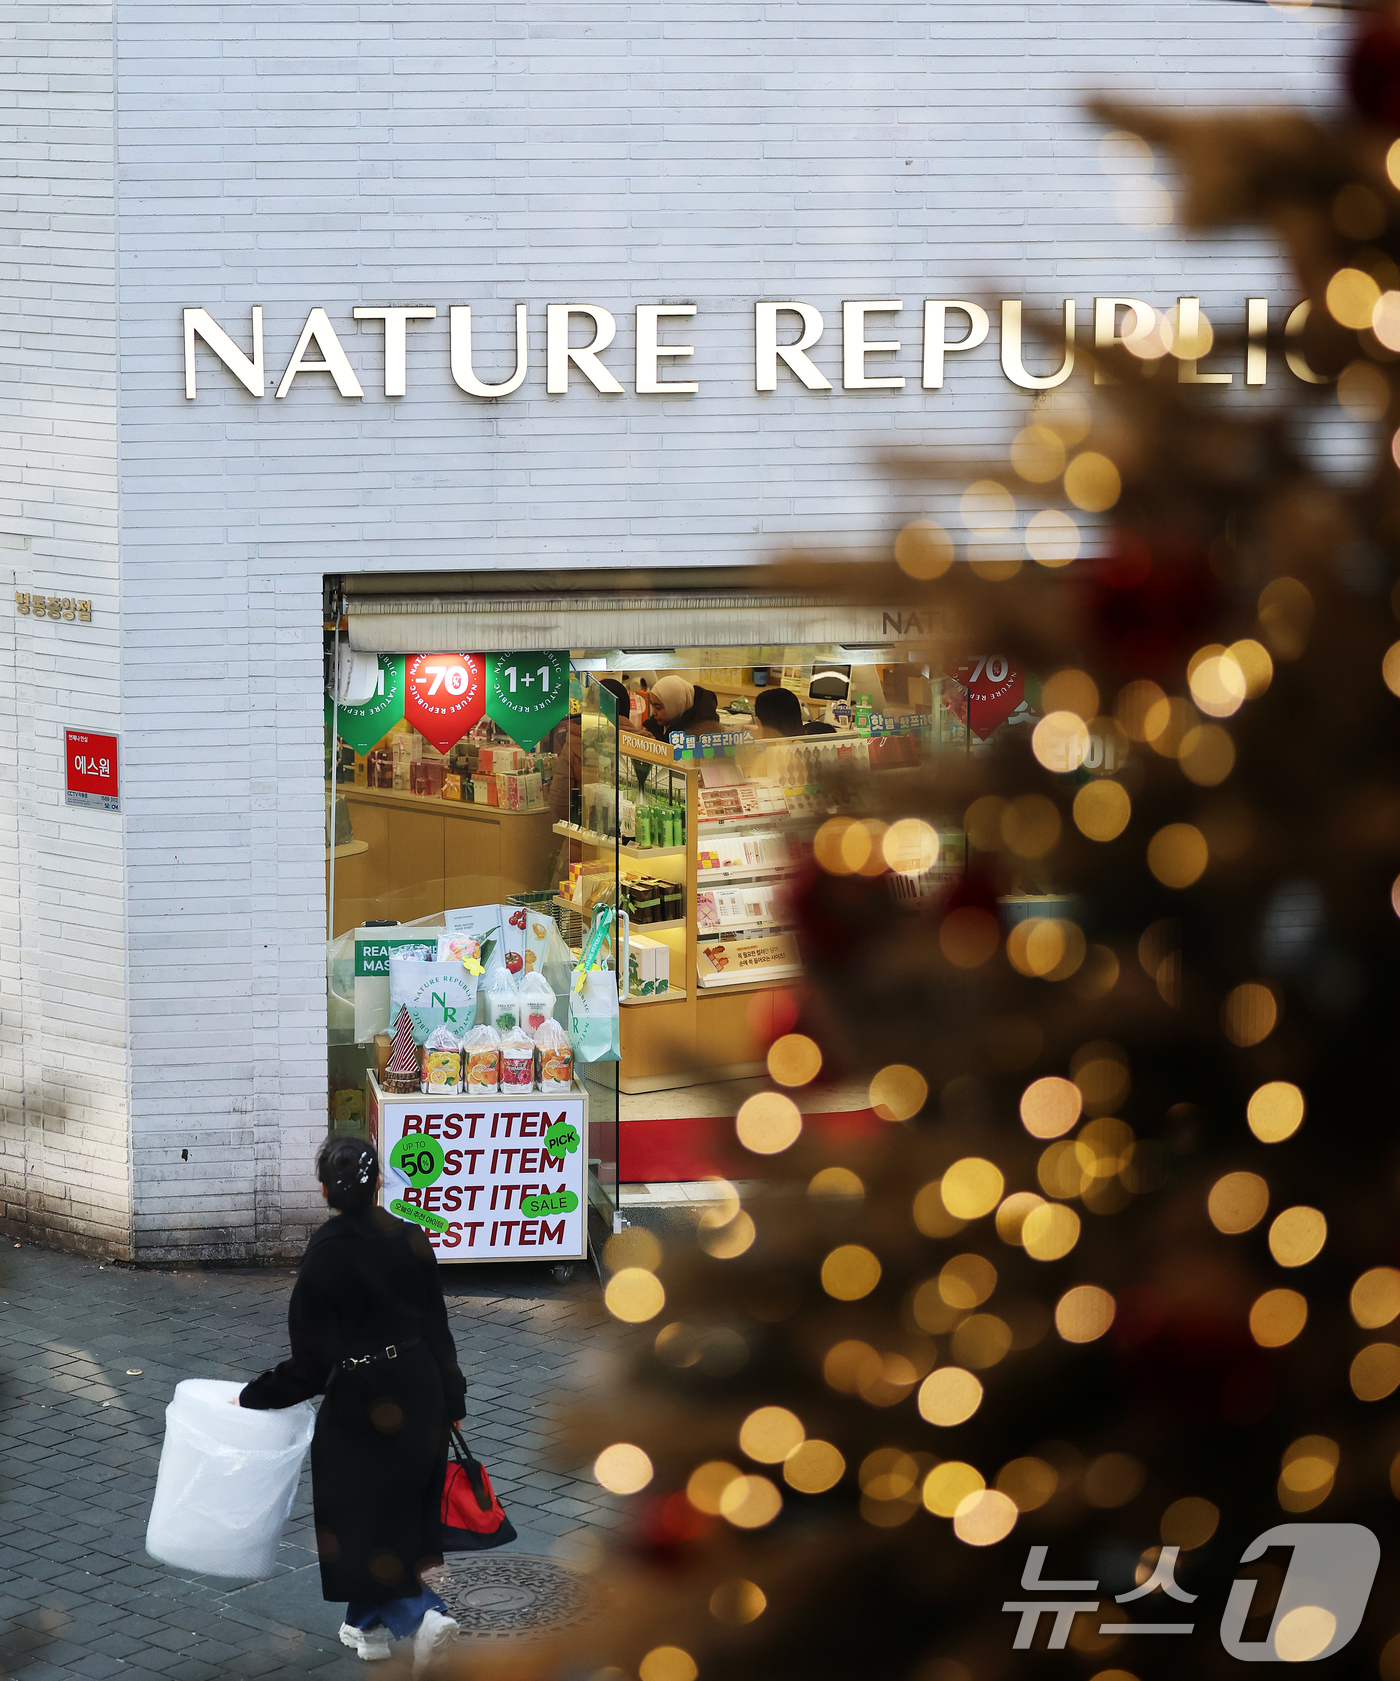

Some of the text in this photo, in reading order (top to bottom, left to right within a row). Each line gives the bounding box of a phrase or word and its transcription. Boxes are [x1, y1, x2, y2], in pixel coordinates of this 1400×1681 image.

[182, 303, 700, 400] NATURE
[15, 592, 92, 622] 명동중앙점
[409, 653, 430, 676] NATU
[504, 666, 550, 693] 1+1
[368, 686, 397, 716] NATURE
[409, 684, 478, 715] NATURE REPUBLIC
[493, 682, 562, 713] NATURE REPUBLIC
[622, 734, 668, 757] PROMOTION
[671, 731, 754, 750] 핫템 핫프라이스
[74, 755, 110, 778] 에스원
[363, 960, 390, 972] MAS
[413, 976, 440, 1003] NATURE
[402, 1113, 485, 1140] BEST
[402, 1140, 426, 1152] UP TO
[549, 1131, 576, 1150] PICK
[442, 1148, 566, 1176] ST ITEM
[402, 1185, 485, 1212] BEST
[530, 1197, 568, 1212] SALE
[394, 1202, 445, 1229] 오늘의 추천 아이템
[425, 1219, 567, 1248] EST ITEM
